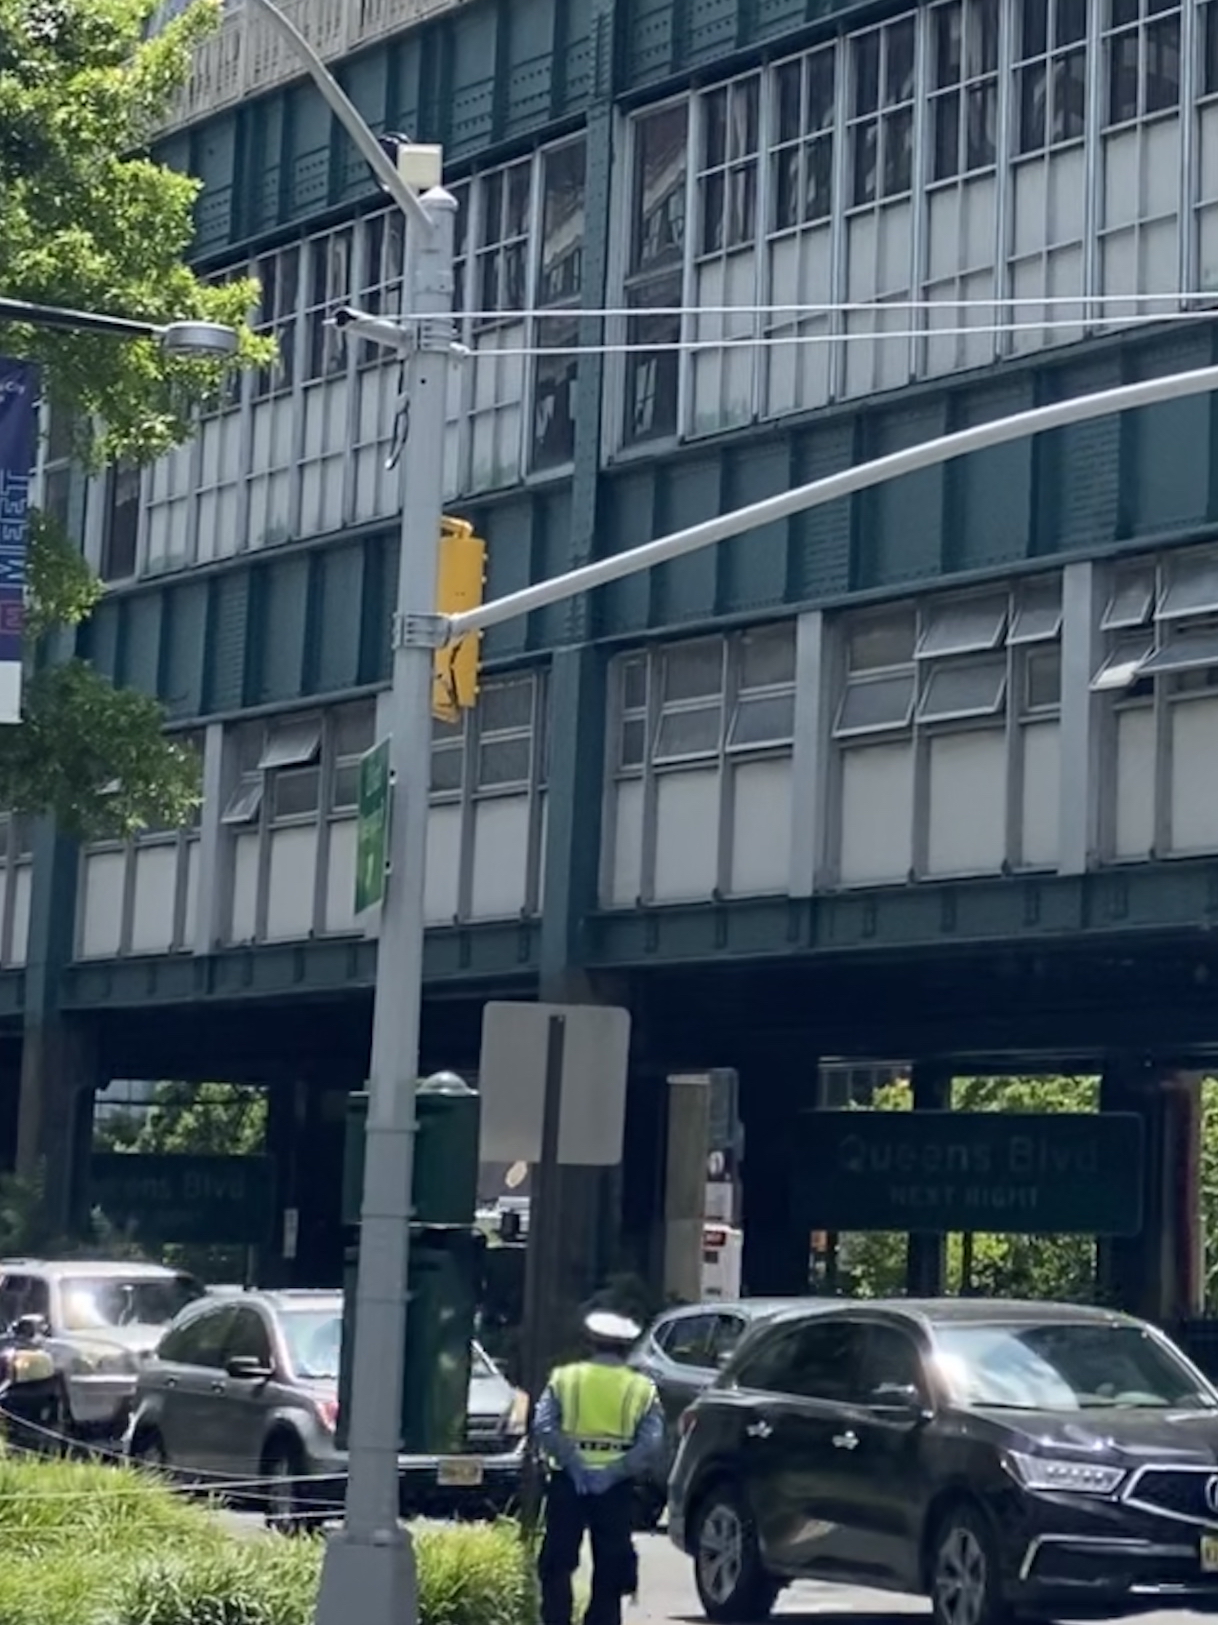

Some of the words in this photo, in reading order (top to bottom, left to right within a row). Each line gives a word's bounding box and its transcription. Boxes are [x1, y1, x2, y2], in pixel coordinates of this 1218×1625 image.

[838, 1133, 992, 1173] Queens
[1009, 1135, 1099, 1173] Blvd
[889, 1184, 956, 1207] NEXT
[965, 1184, 1039, 1209] RIGHT
